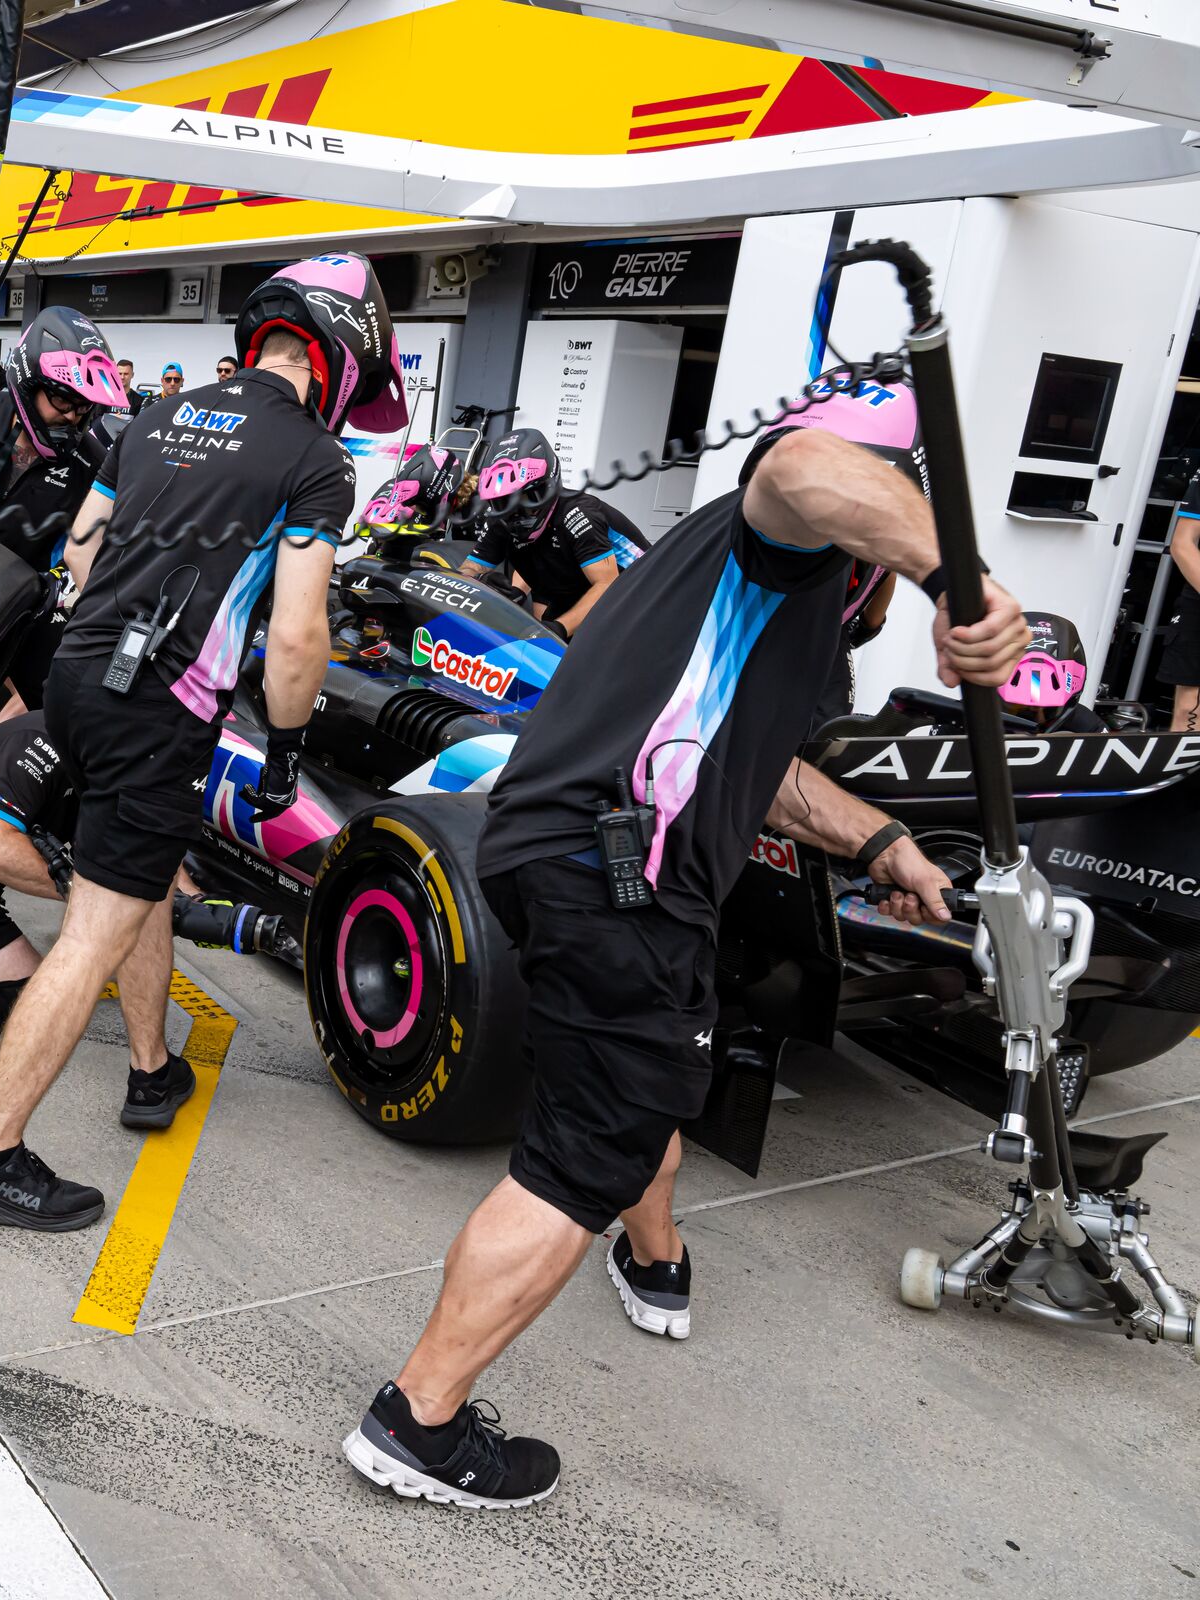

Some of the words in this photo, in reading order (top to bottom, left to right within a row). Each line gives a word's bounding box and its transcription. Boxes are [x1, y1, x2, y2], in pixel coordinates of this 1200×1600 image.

[170, 118, 346, 155] ALPINE
[611, 251, 692, 274] PIERRE
[548, 260, 583, 300] 10
[604, 275, 677, 298] GASLY
[12, 292, 23, 305] 36
[182, 284, 197, 301] 35
[358, 317, 372, 350] JAAQ
[370, 315, 383, 359] shamir
[574, 341, 593, 350] BWT
[338, 373, 353, 410] BINANCE
[403, 376, 428, 387] INE
[188, 408, 248, 433] BWT
[147, 429, 243, 451] ALPINE
[179, 449, 208, 461] TEAM
[400, 577, 482, 613] E-TECH
[423, 572, 481, 595] RENAULT
[431, 641, 517, 699] Castrol
[41, 743, 61, 764] BWT
[840, 735, 1200, 782] ALPINE
[380, 1054, 453, 1123] ZERO
